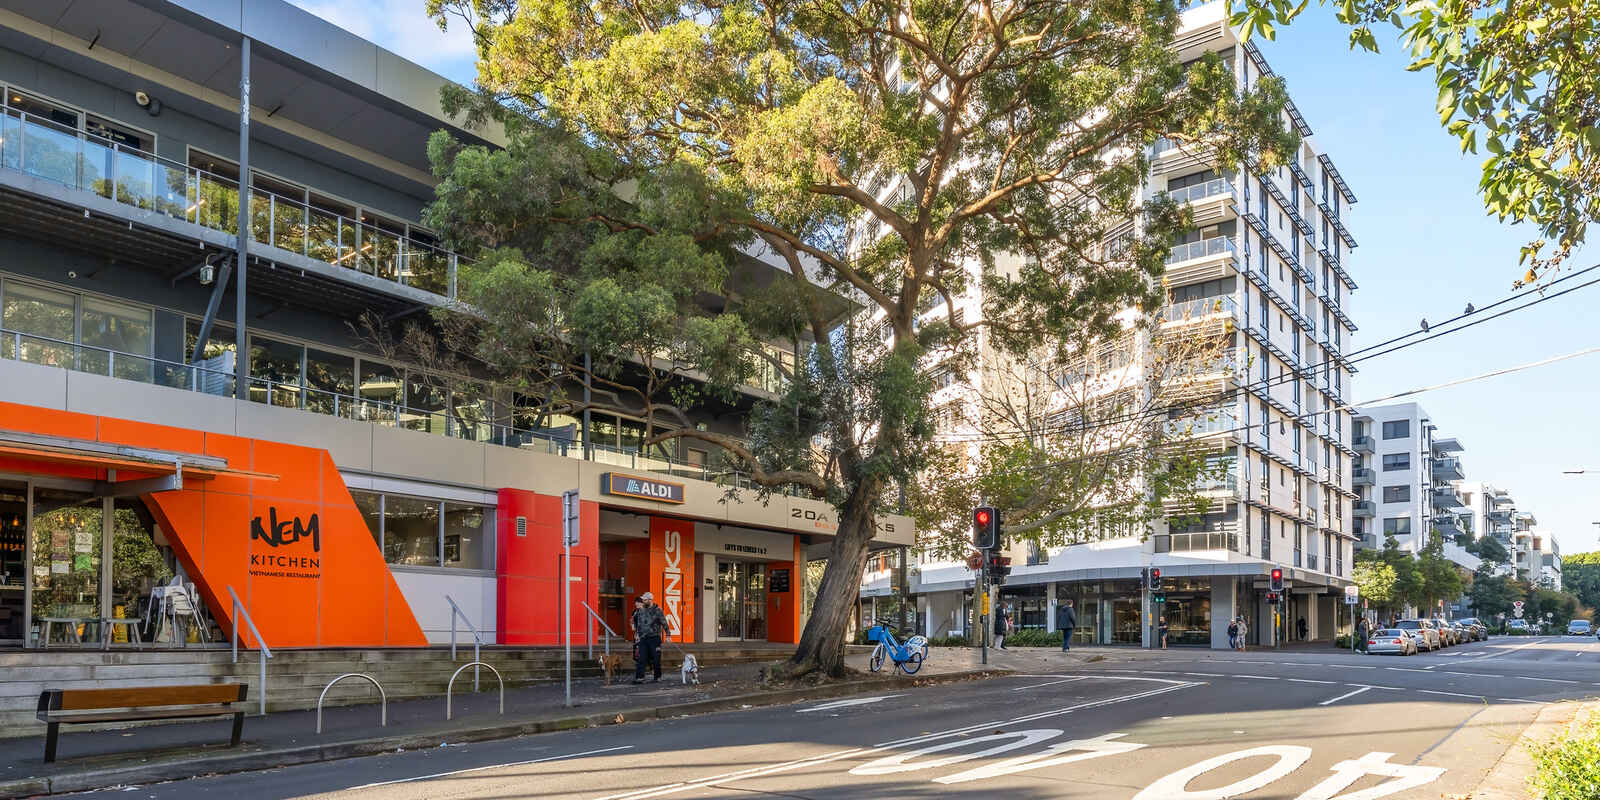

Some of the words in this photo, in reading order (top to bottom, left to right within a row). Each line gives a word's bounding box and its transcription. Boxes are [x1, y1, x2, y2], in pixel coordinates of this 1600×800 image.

[641, 482, 672, 498] ALDI
[791, 508, 828, 522] 20A
[250, 506, 320, 552] NEM
[250, 554, 320, 568] KITCHEN
[249, 569, 285, 577] VIETNAMESE
